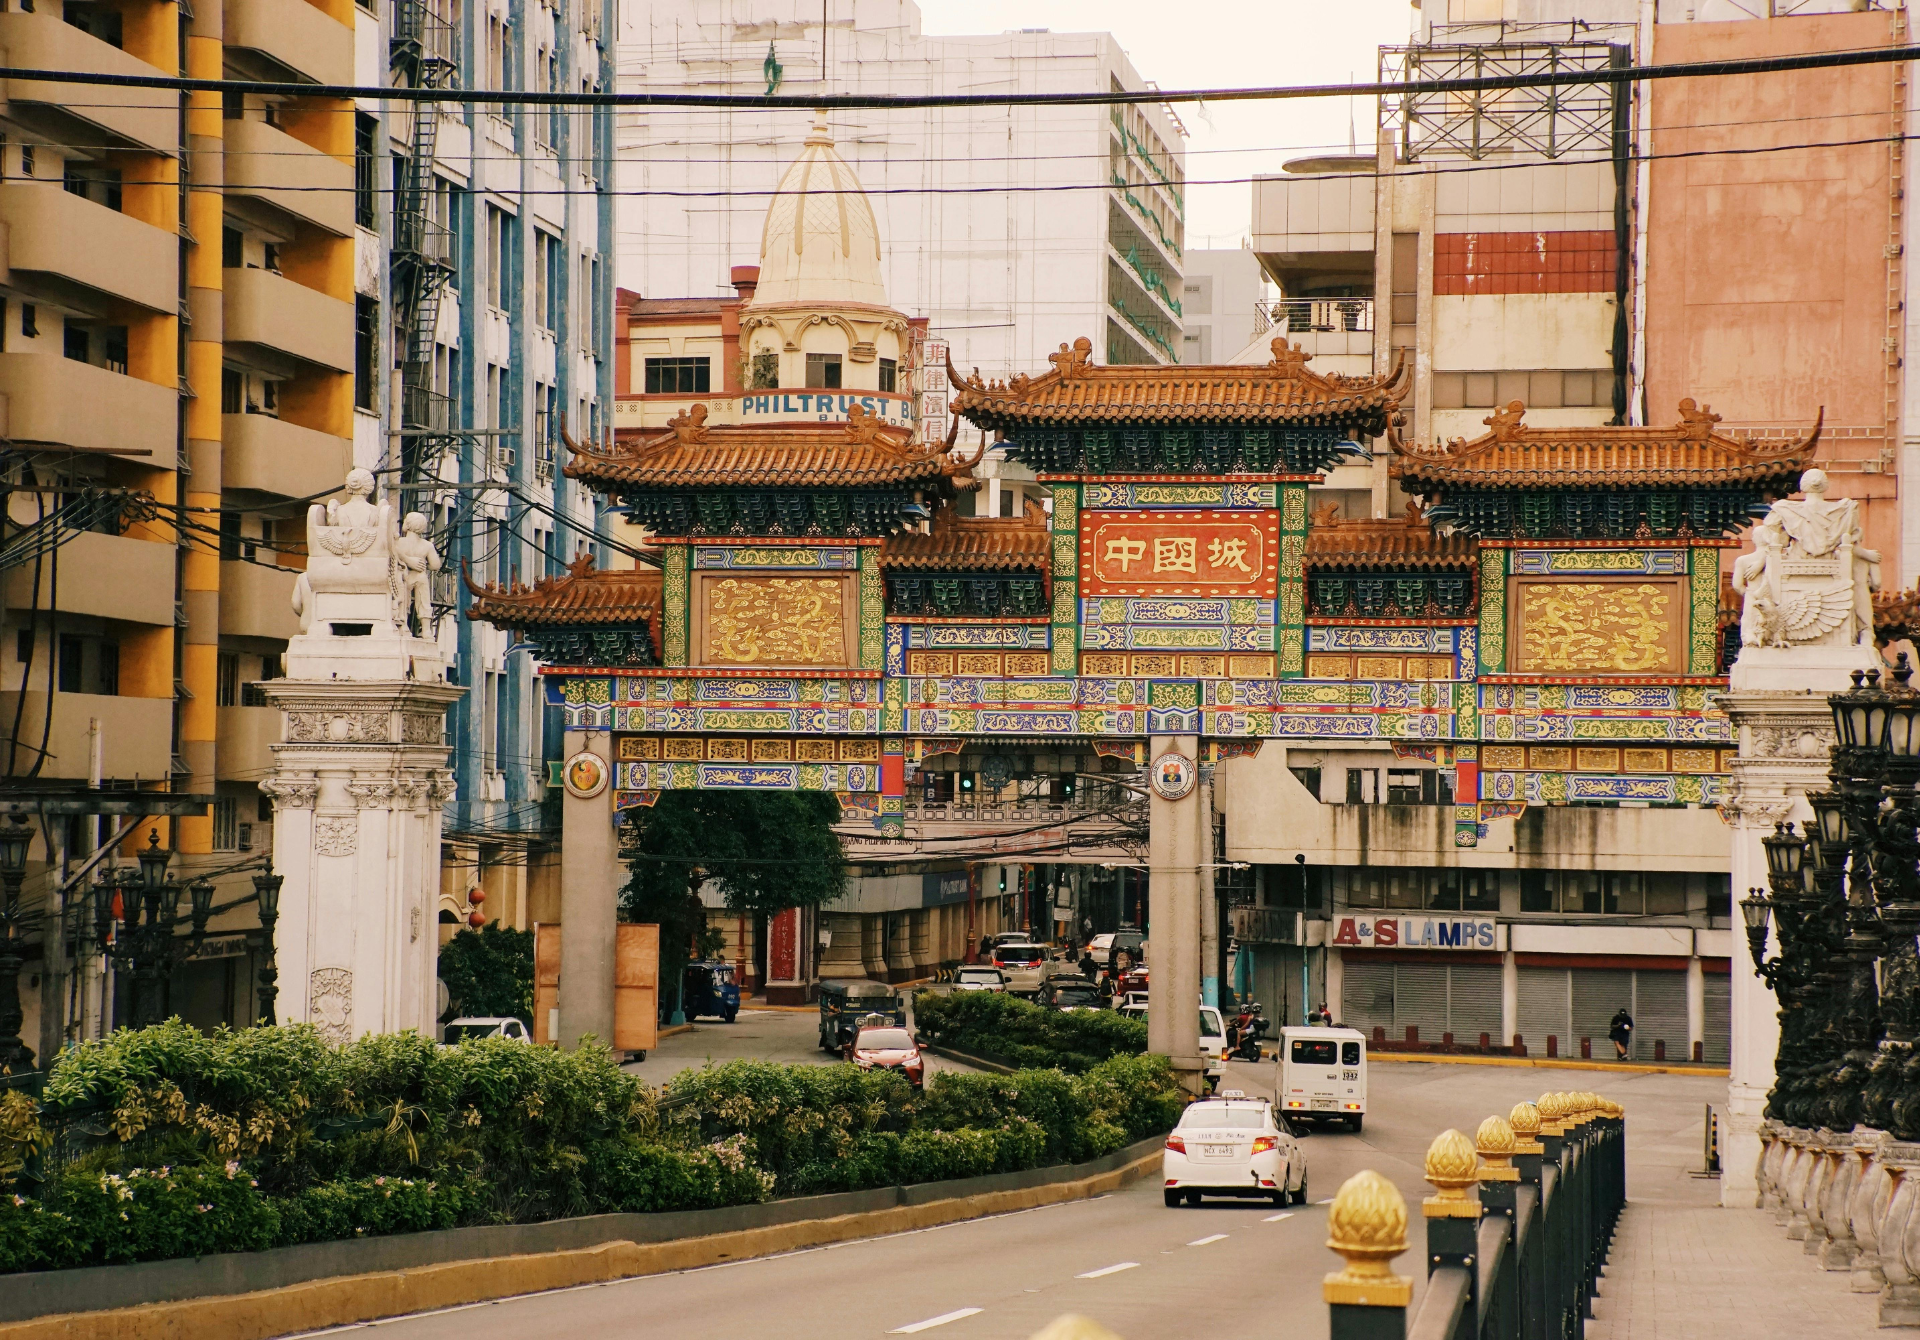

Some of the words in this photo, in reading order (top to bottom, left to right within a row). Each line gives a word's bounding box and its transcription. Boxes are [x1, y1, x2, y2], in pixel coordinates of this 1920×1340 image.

[743, 394, 890, 416] PHILTRUST
[901, 401, 913, 420] B
[818, 414, 905, 427] BINDO
[1103, 536, 1252, 573] 中國城
[1333, 918, 1398, 945] A&S
[1405, 921, 1493, 947] LAMPS
